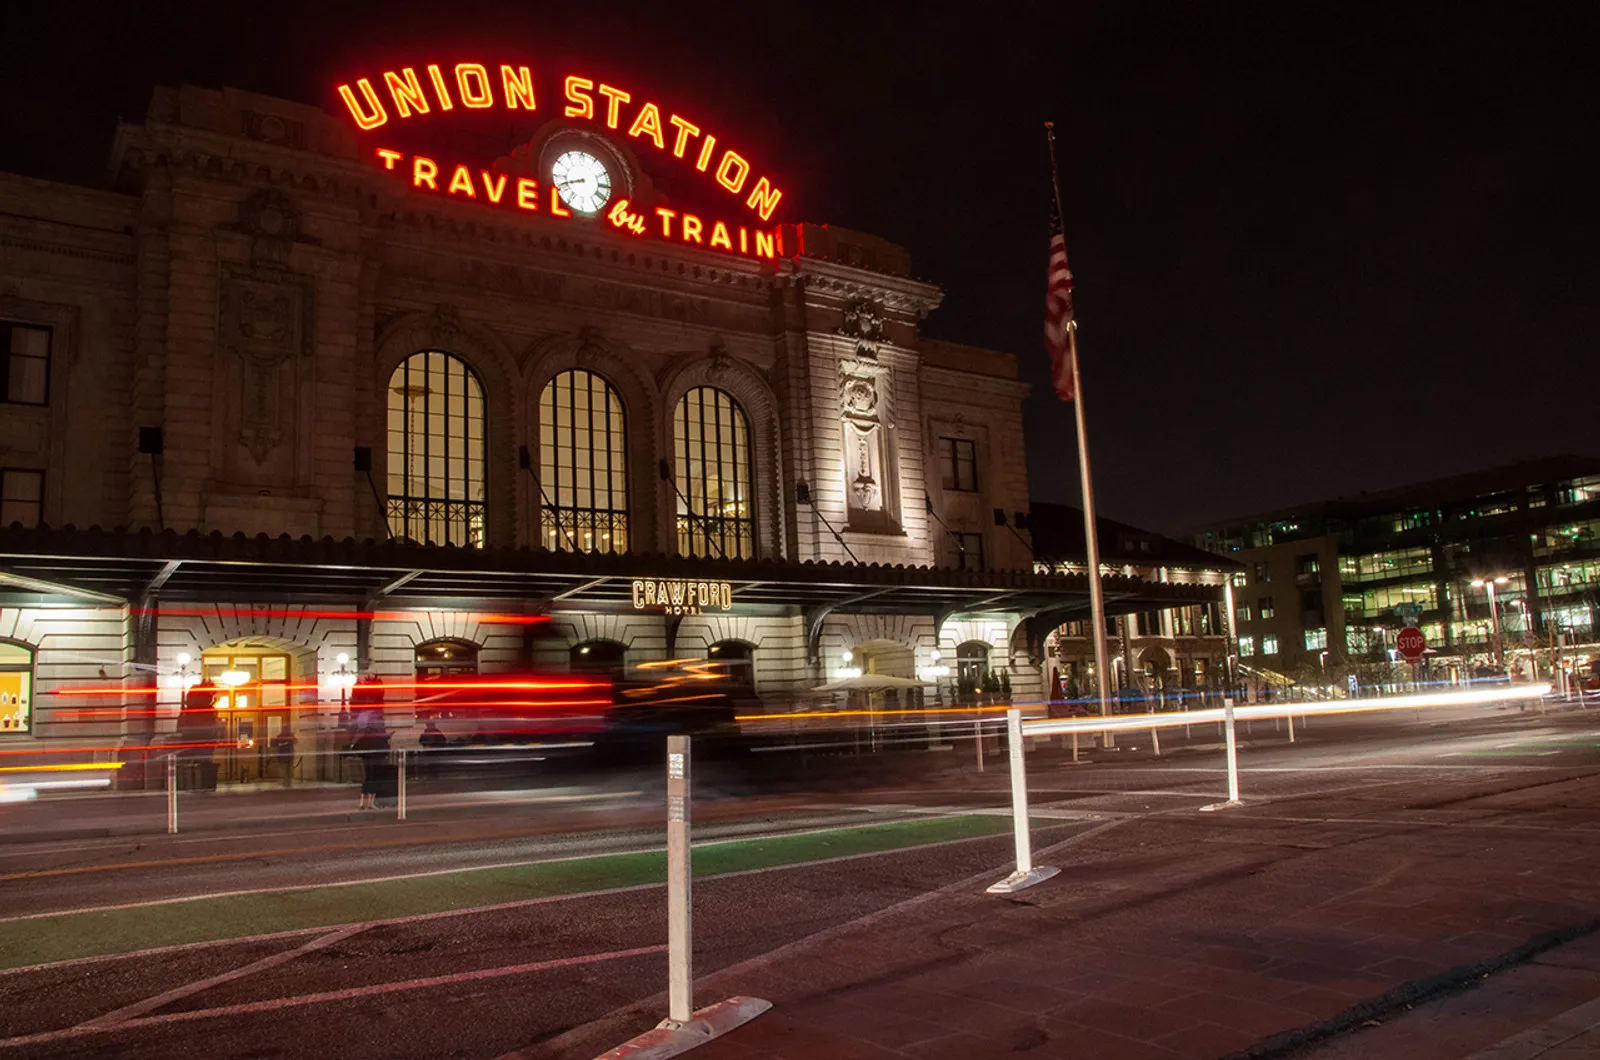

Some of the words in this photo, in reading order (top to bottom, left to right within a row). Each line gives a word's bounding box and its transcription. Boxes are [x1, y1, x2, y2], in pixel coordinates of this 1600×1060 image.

[338, 63, 536, 130] UNION
[565, 76, 782, 220] STATION
[377, 148, 570, 217] TRAVEL
[608, 200, 646, 235] by
[657, 208, 774, 258] TRAIN
[632, 580, 731, 609] CRAWFORD
[665, 606, 703, 615] HOTEL
[1400, 636, 1424, 649] STOP
